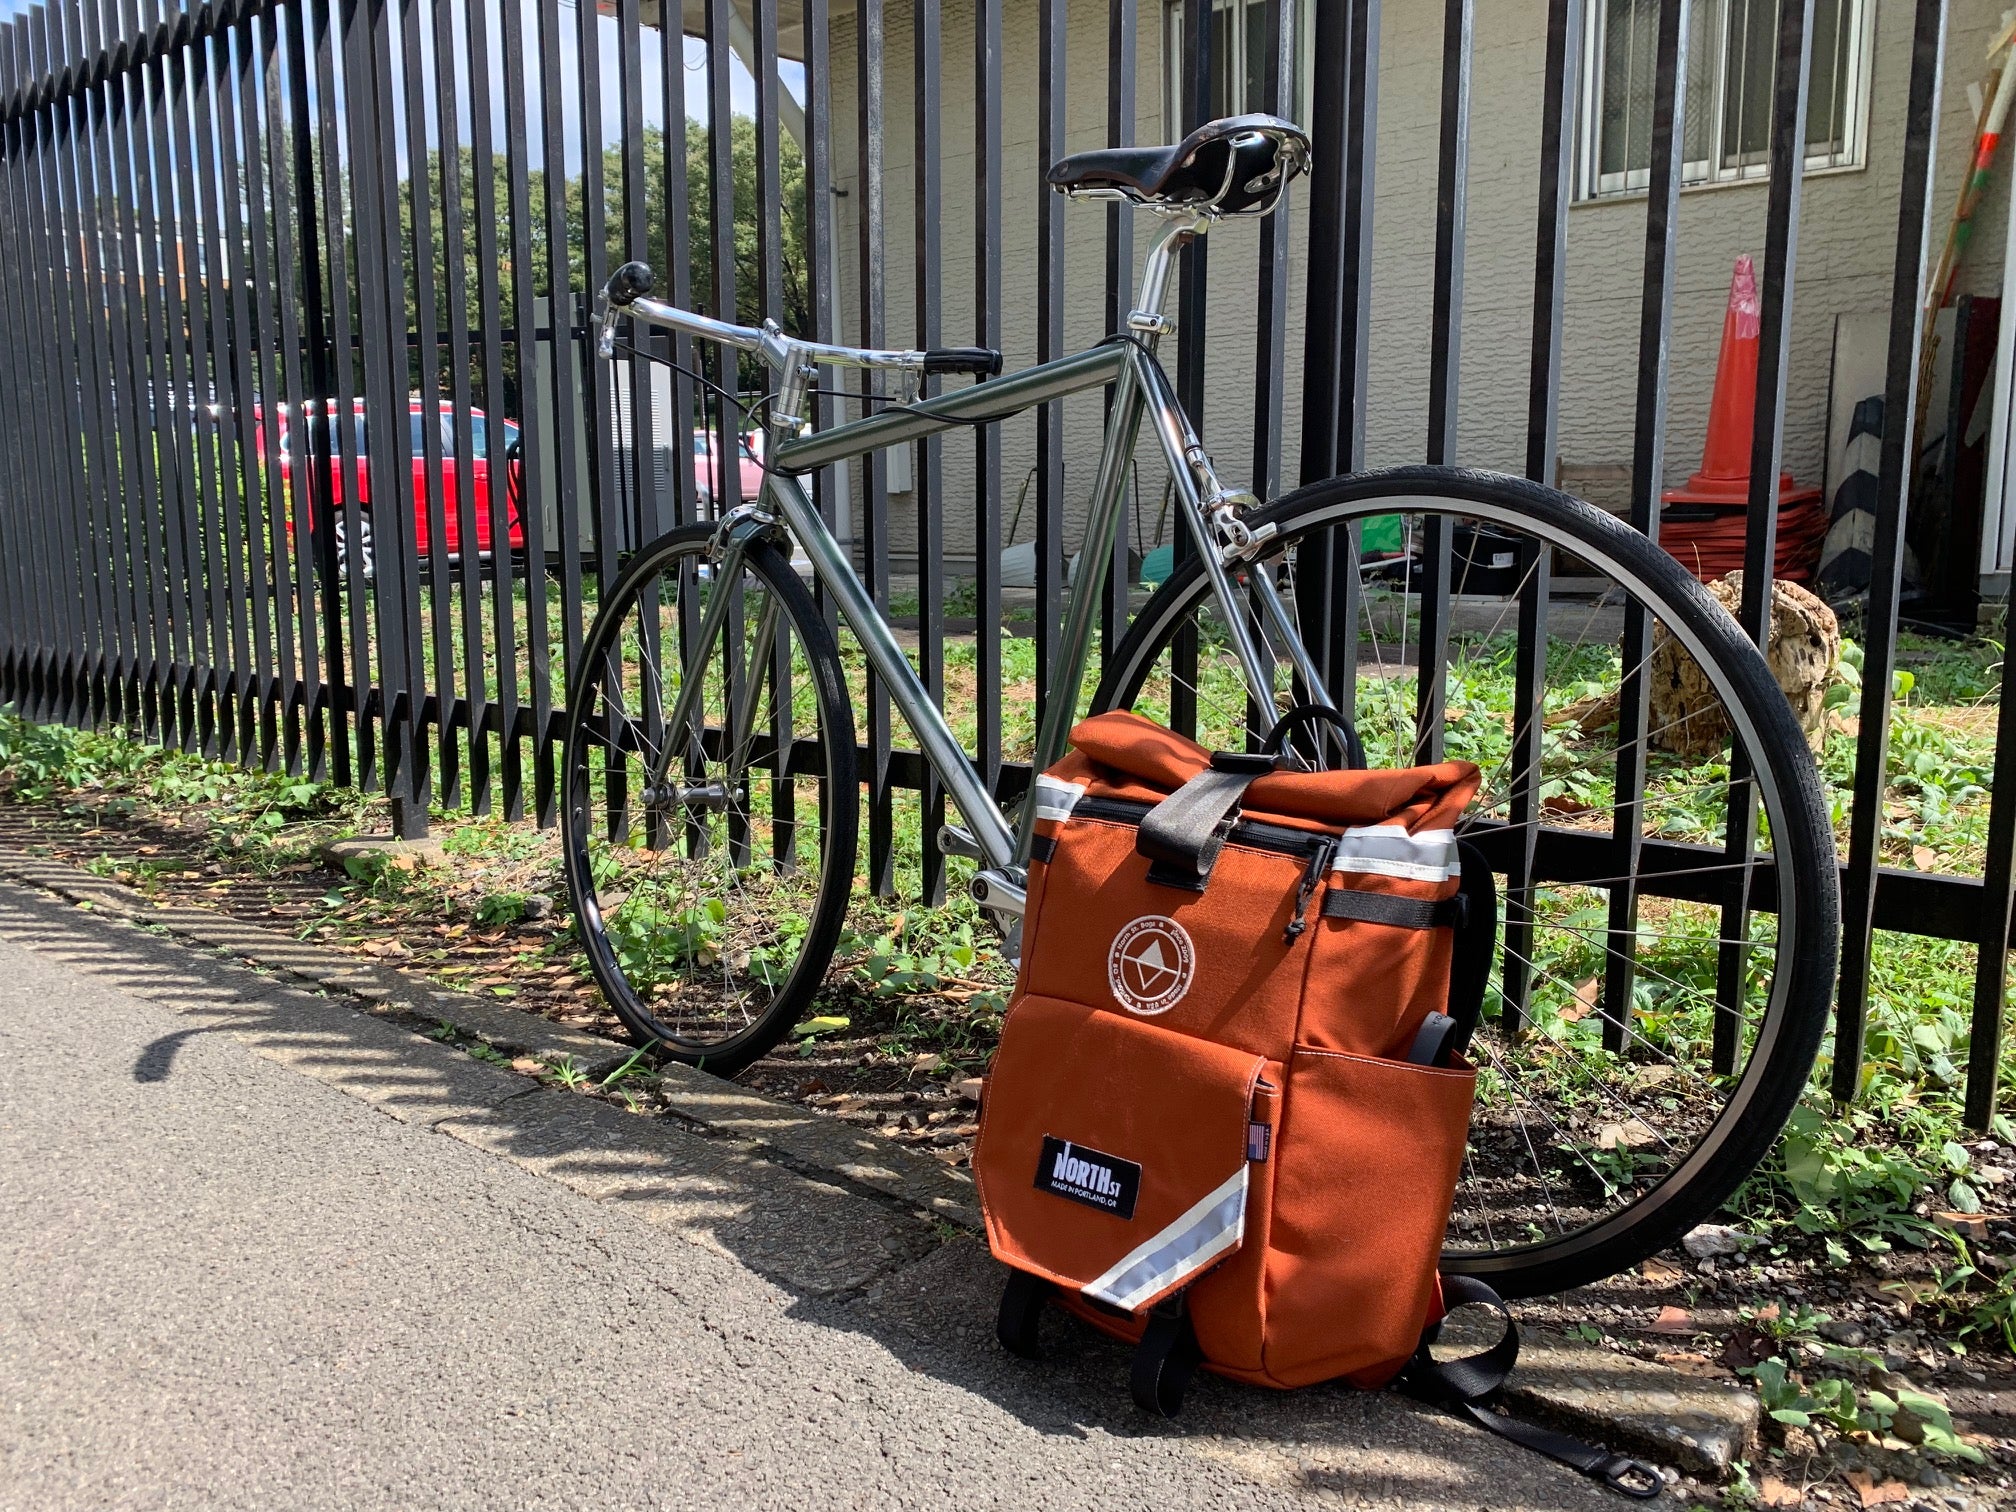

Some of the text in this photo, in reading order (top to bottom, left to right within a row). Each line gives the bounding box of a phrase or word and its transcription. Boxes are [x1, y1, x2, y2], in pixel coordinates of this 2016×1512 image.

[1117, 932, 1131, 950] North
[1052, 1141, 1122, 1198] NORTH ST
[1050, 1180, 1117, 1208] MADE IN PORTLAND, OR
